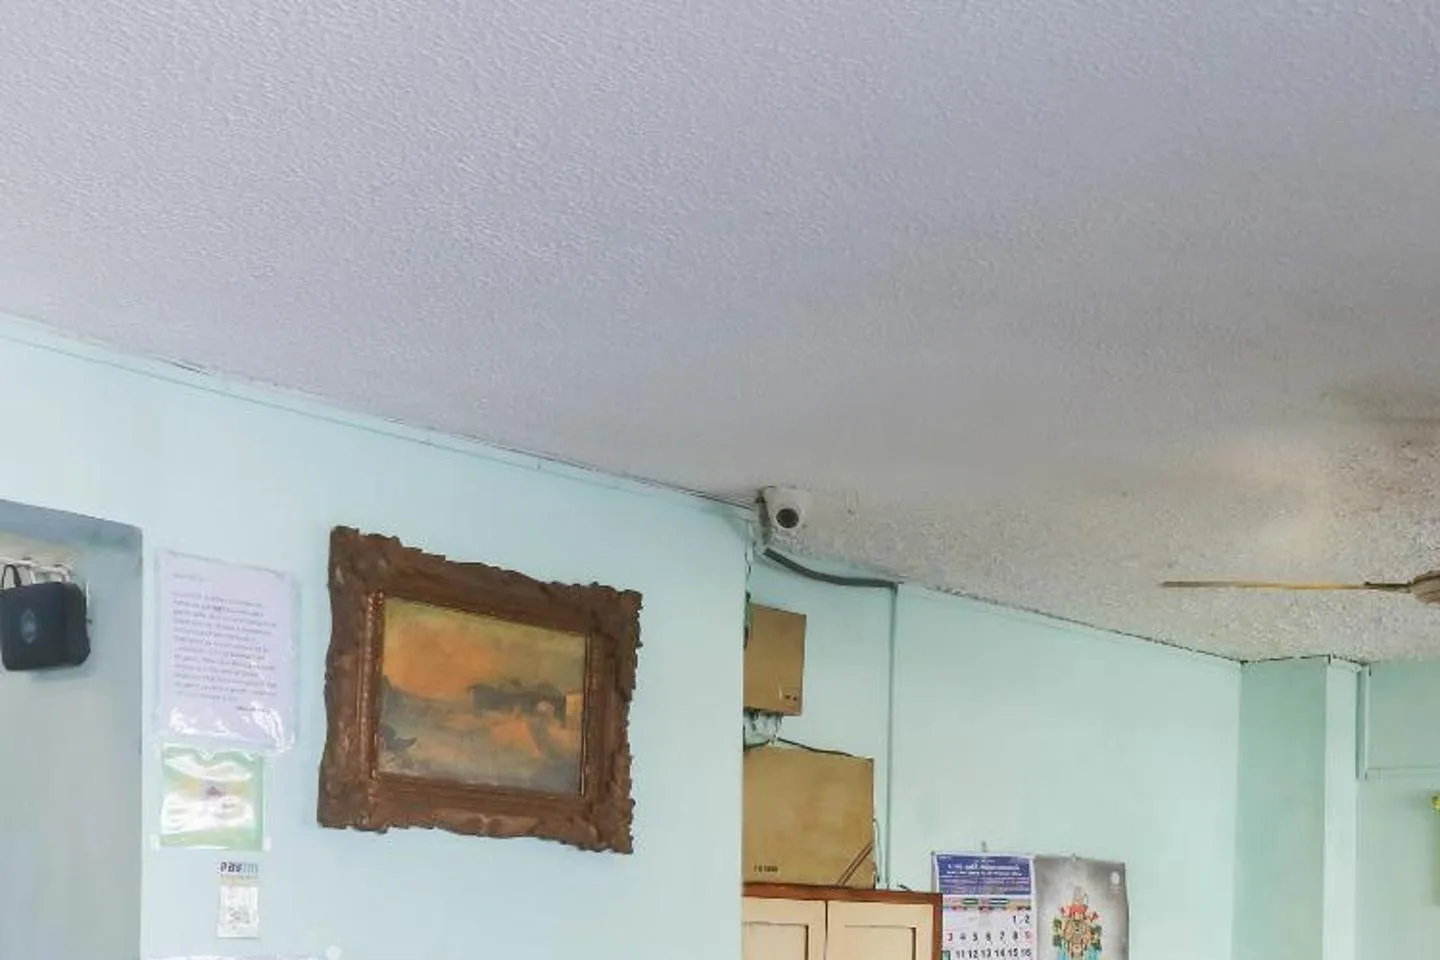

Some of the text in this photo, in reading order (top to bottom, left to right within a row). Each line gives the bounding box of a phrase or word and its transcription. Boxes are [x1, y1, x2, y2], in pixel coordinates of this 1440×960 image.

[955, 950, 964, 958] 11
[968, 950, 978, 958] 12
[981, 948, 991, 958] 13
[994, 948, 1005, 957] 14
[1008, 948, 1018, 957] 15
